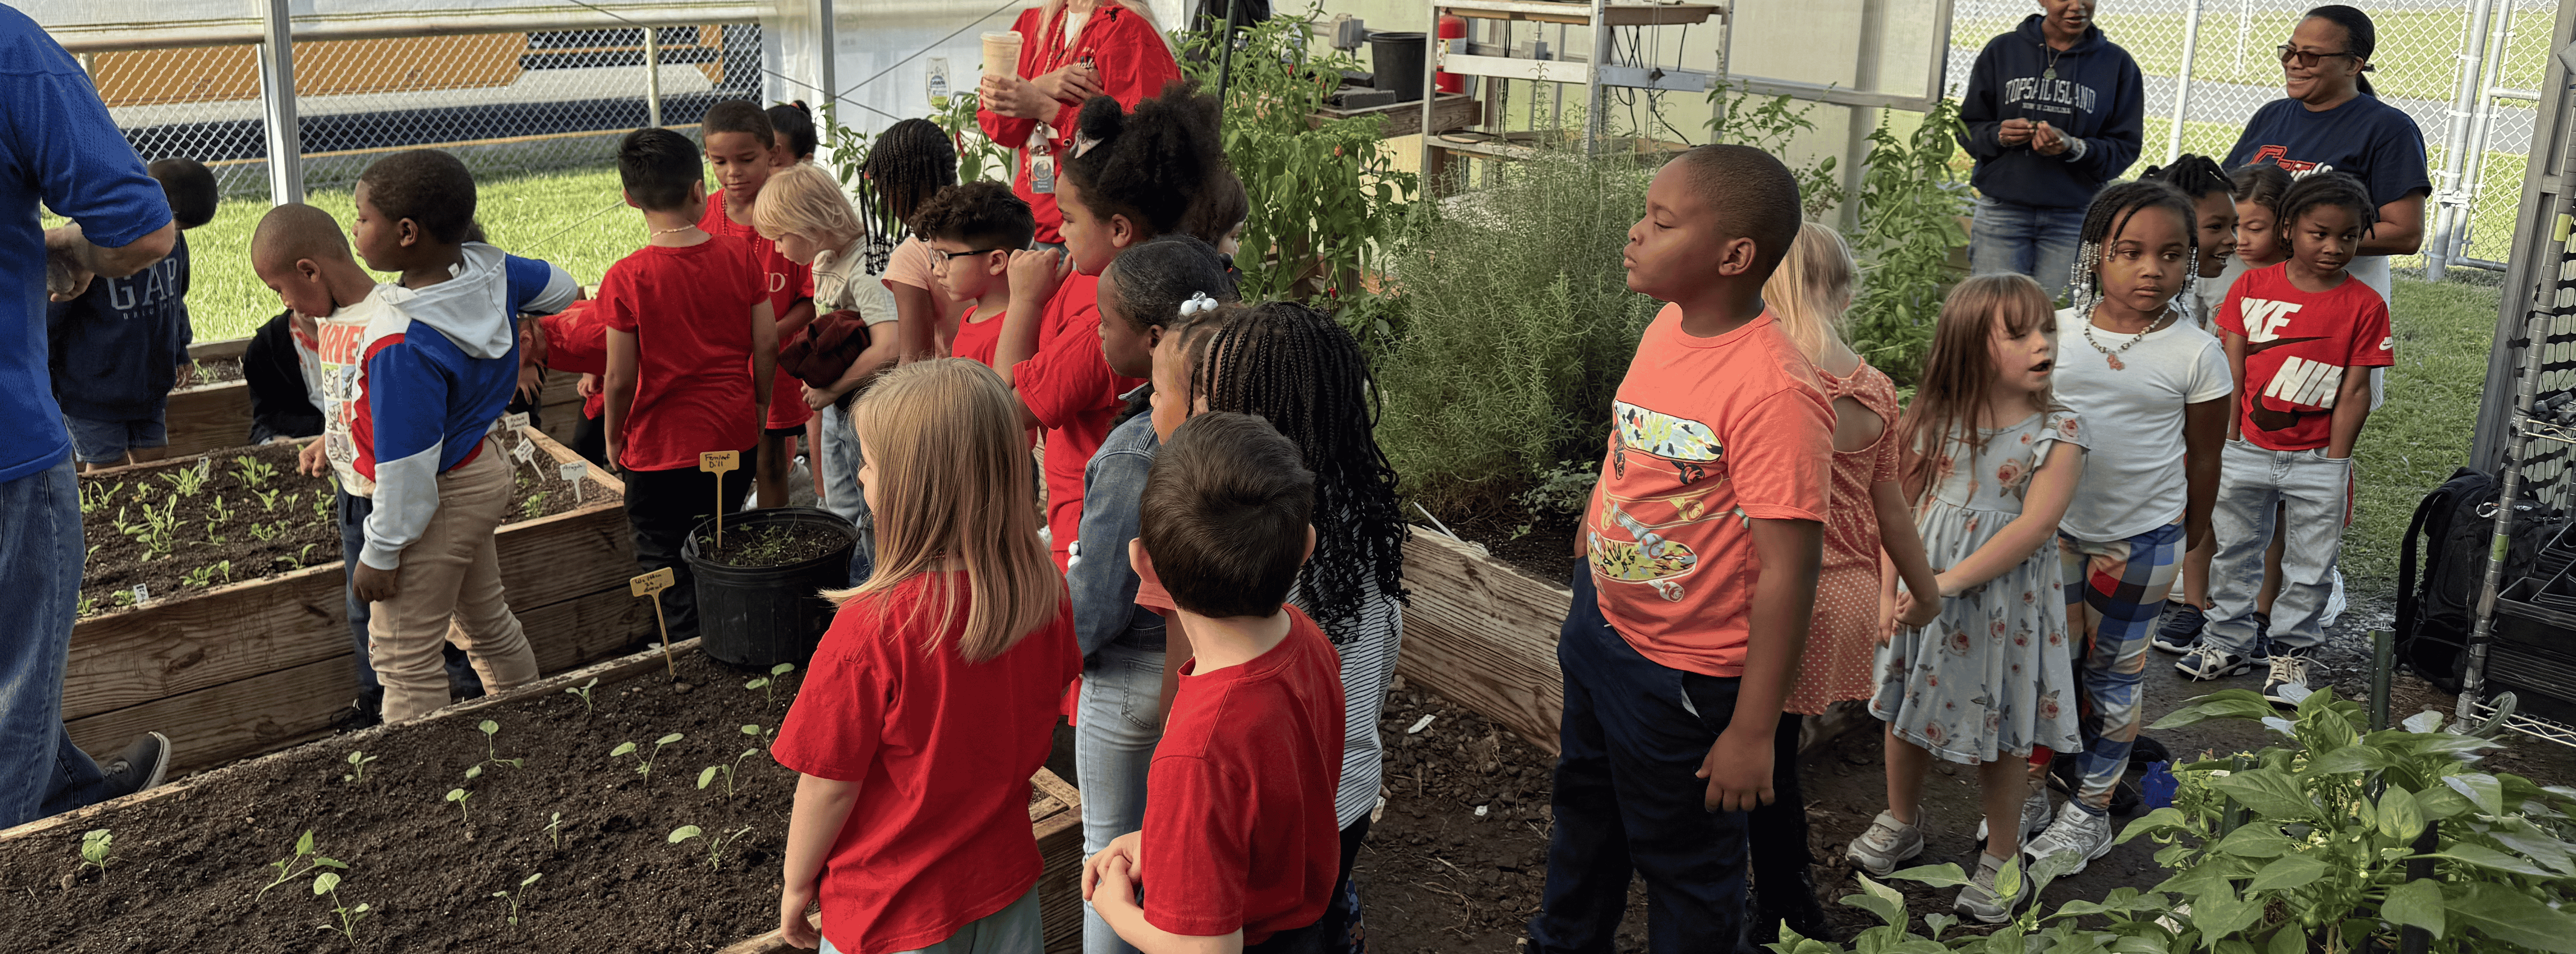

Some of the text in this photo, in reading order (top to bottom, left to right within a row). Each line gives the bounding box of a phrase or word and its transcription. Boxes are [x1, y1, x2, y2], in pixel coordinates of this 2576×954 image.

[2005, 77, 2096, 114] TOPSAIL ISLAND
[106, 258, 177, 310] GAP
[2240, 296, 2303, 343] IKE
[2264, 355, 2344, 409] NIK
